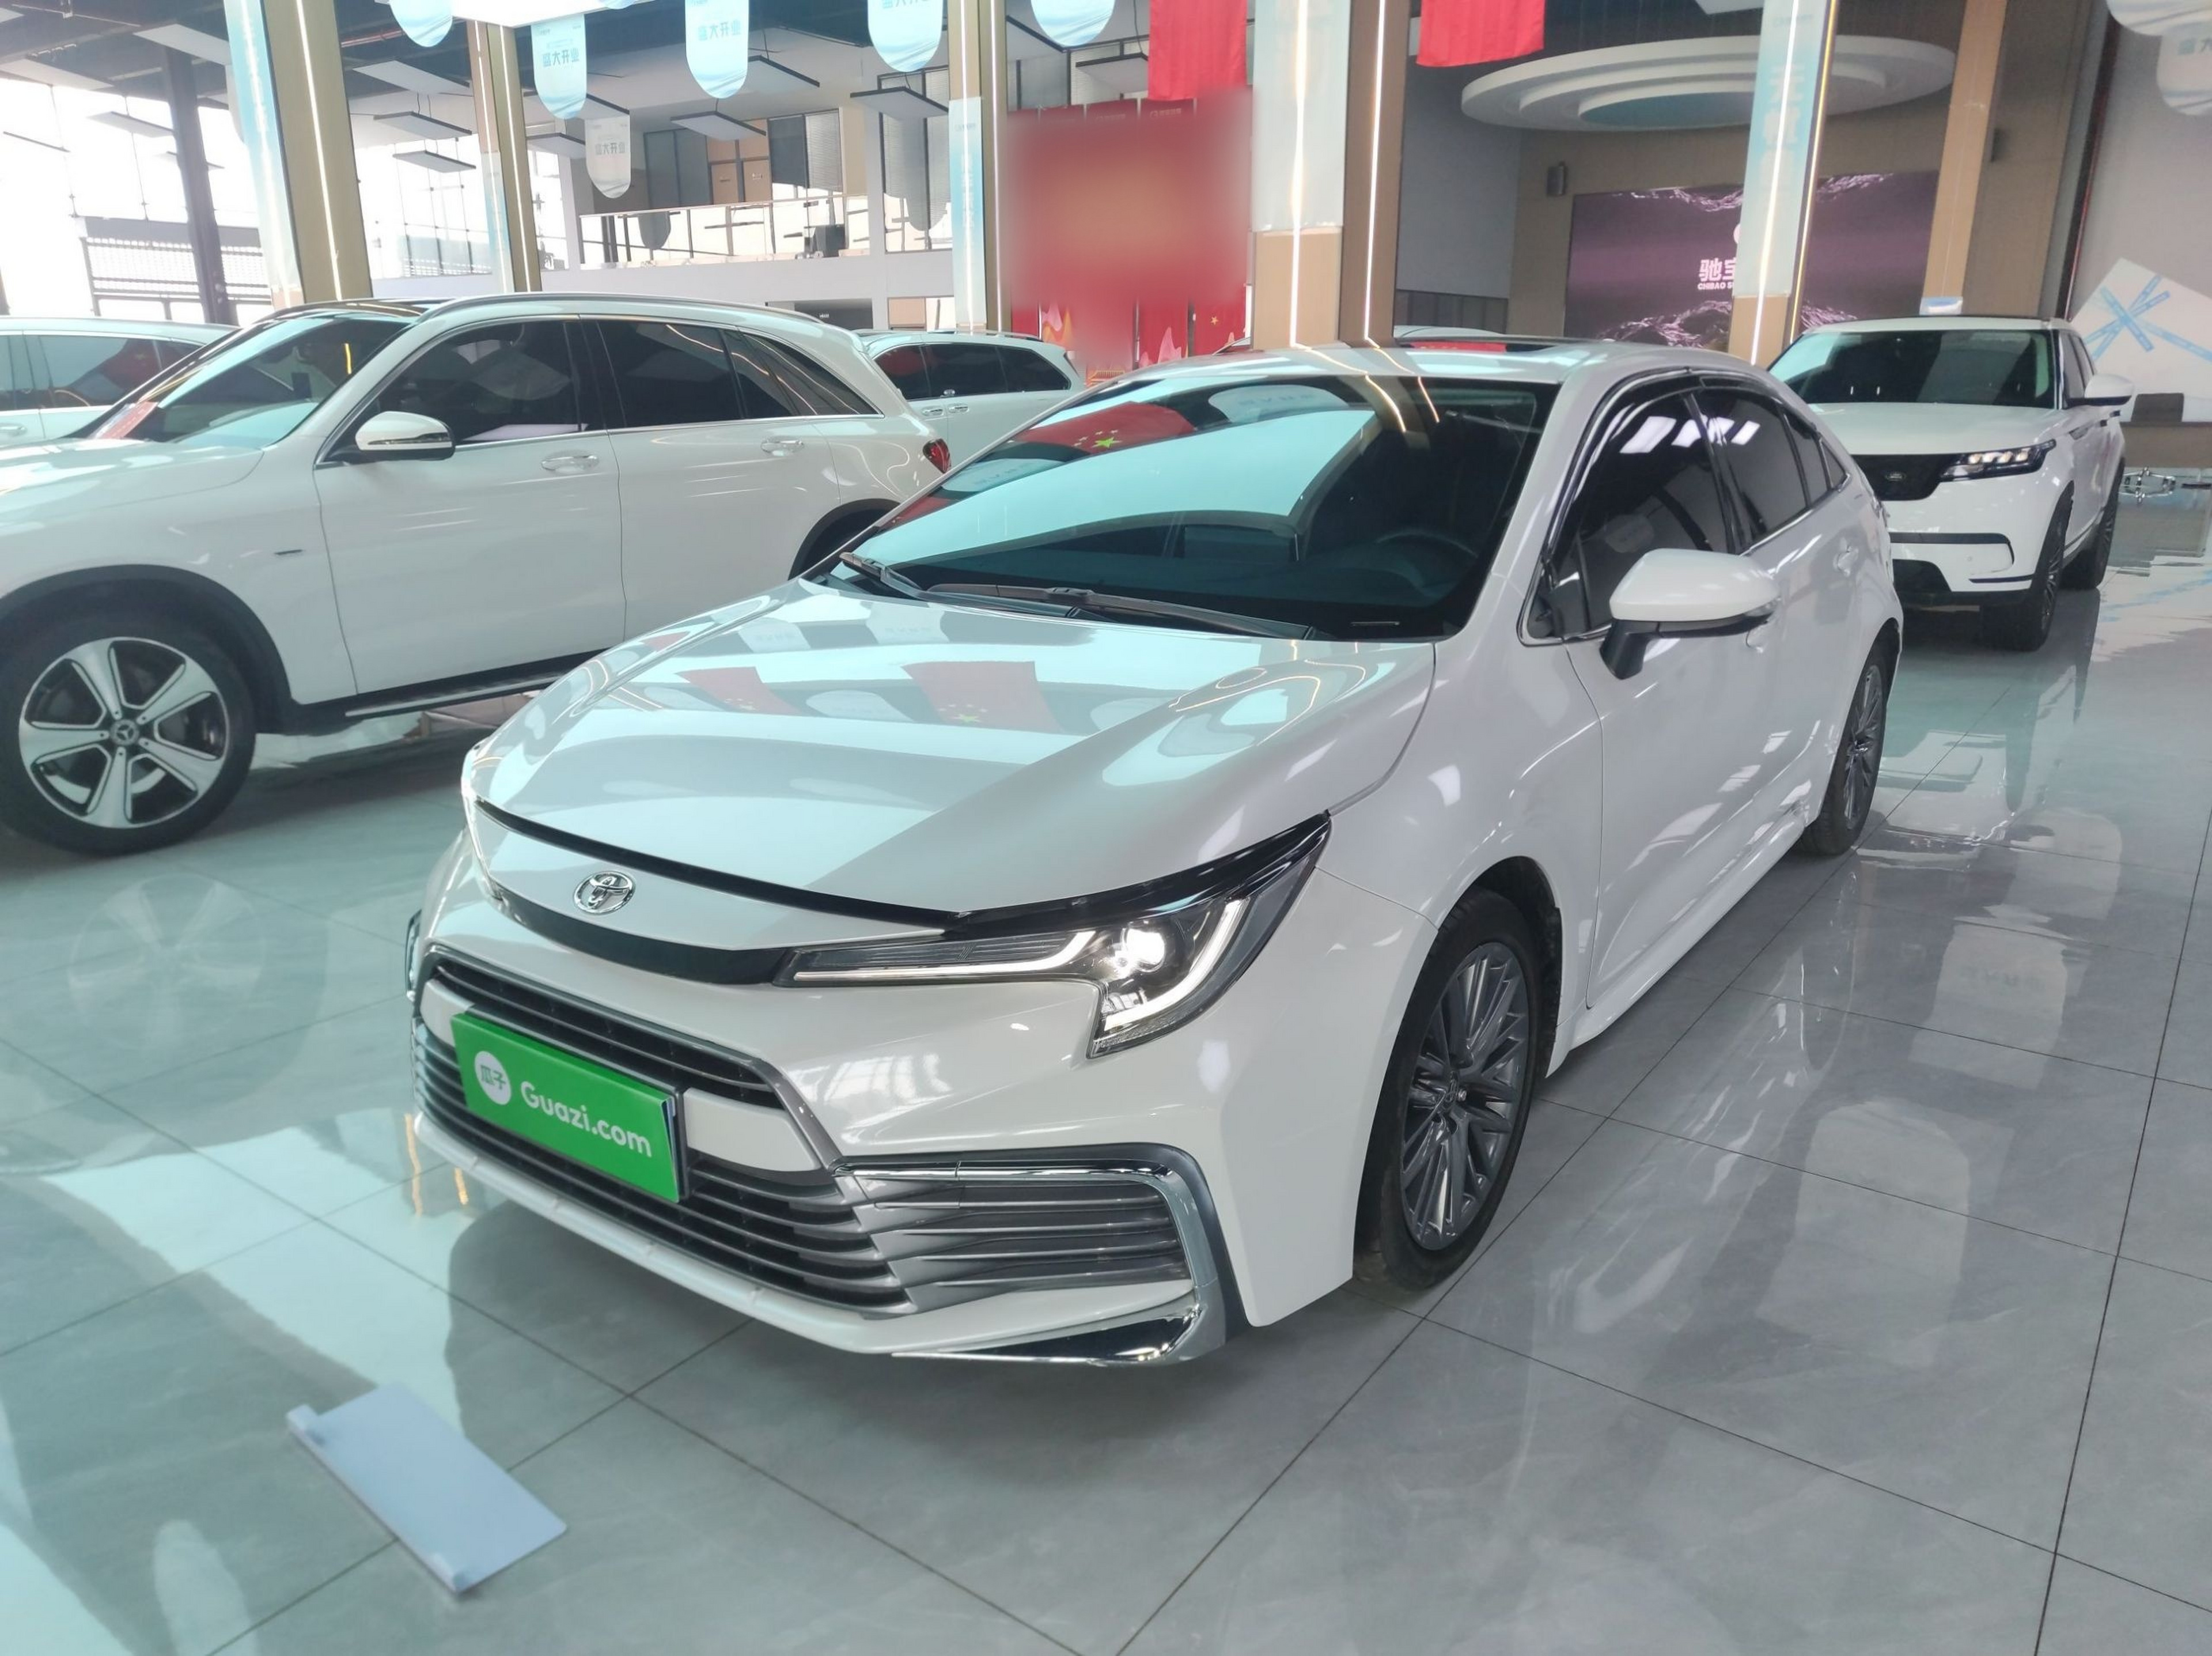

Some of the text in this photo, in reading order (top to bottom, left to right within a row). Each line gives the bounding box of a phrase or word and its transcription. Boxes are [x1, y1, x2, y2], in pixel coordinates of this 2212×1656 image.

[543, 48, 579, 67] 盛大开业
[480, 1064, 506, 1090] 瓜子
[521, 1081, 652, 1158] Guazi.com
